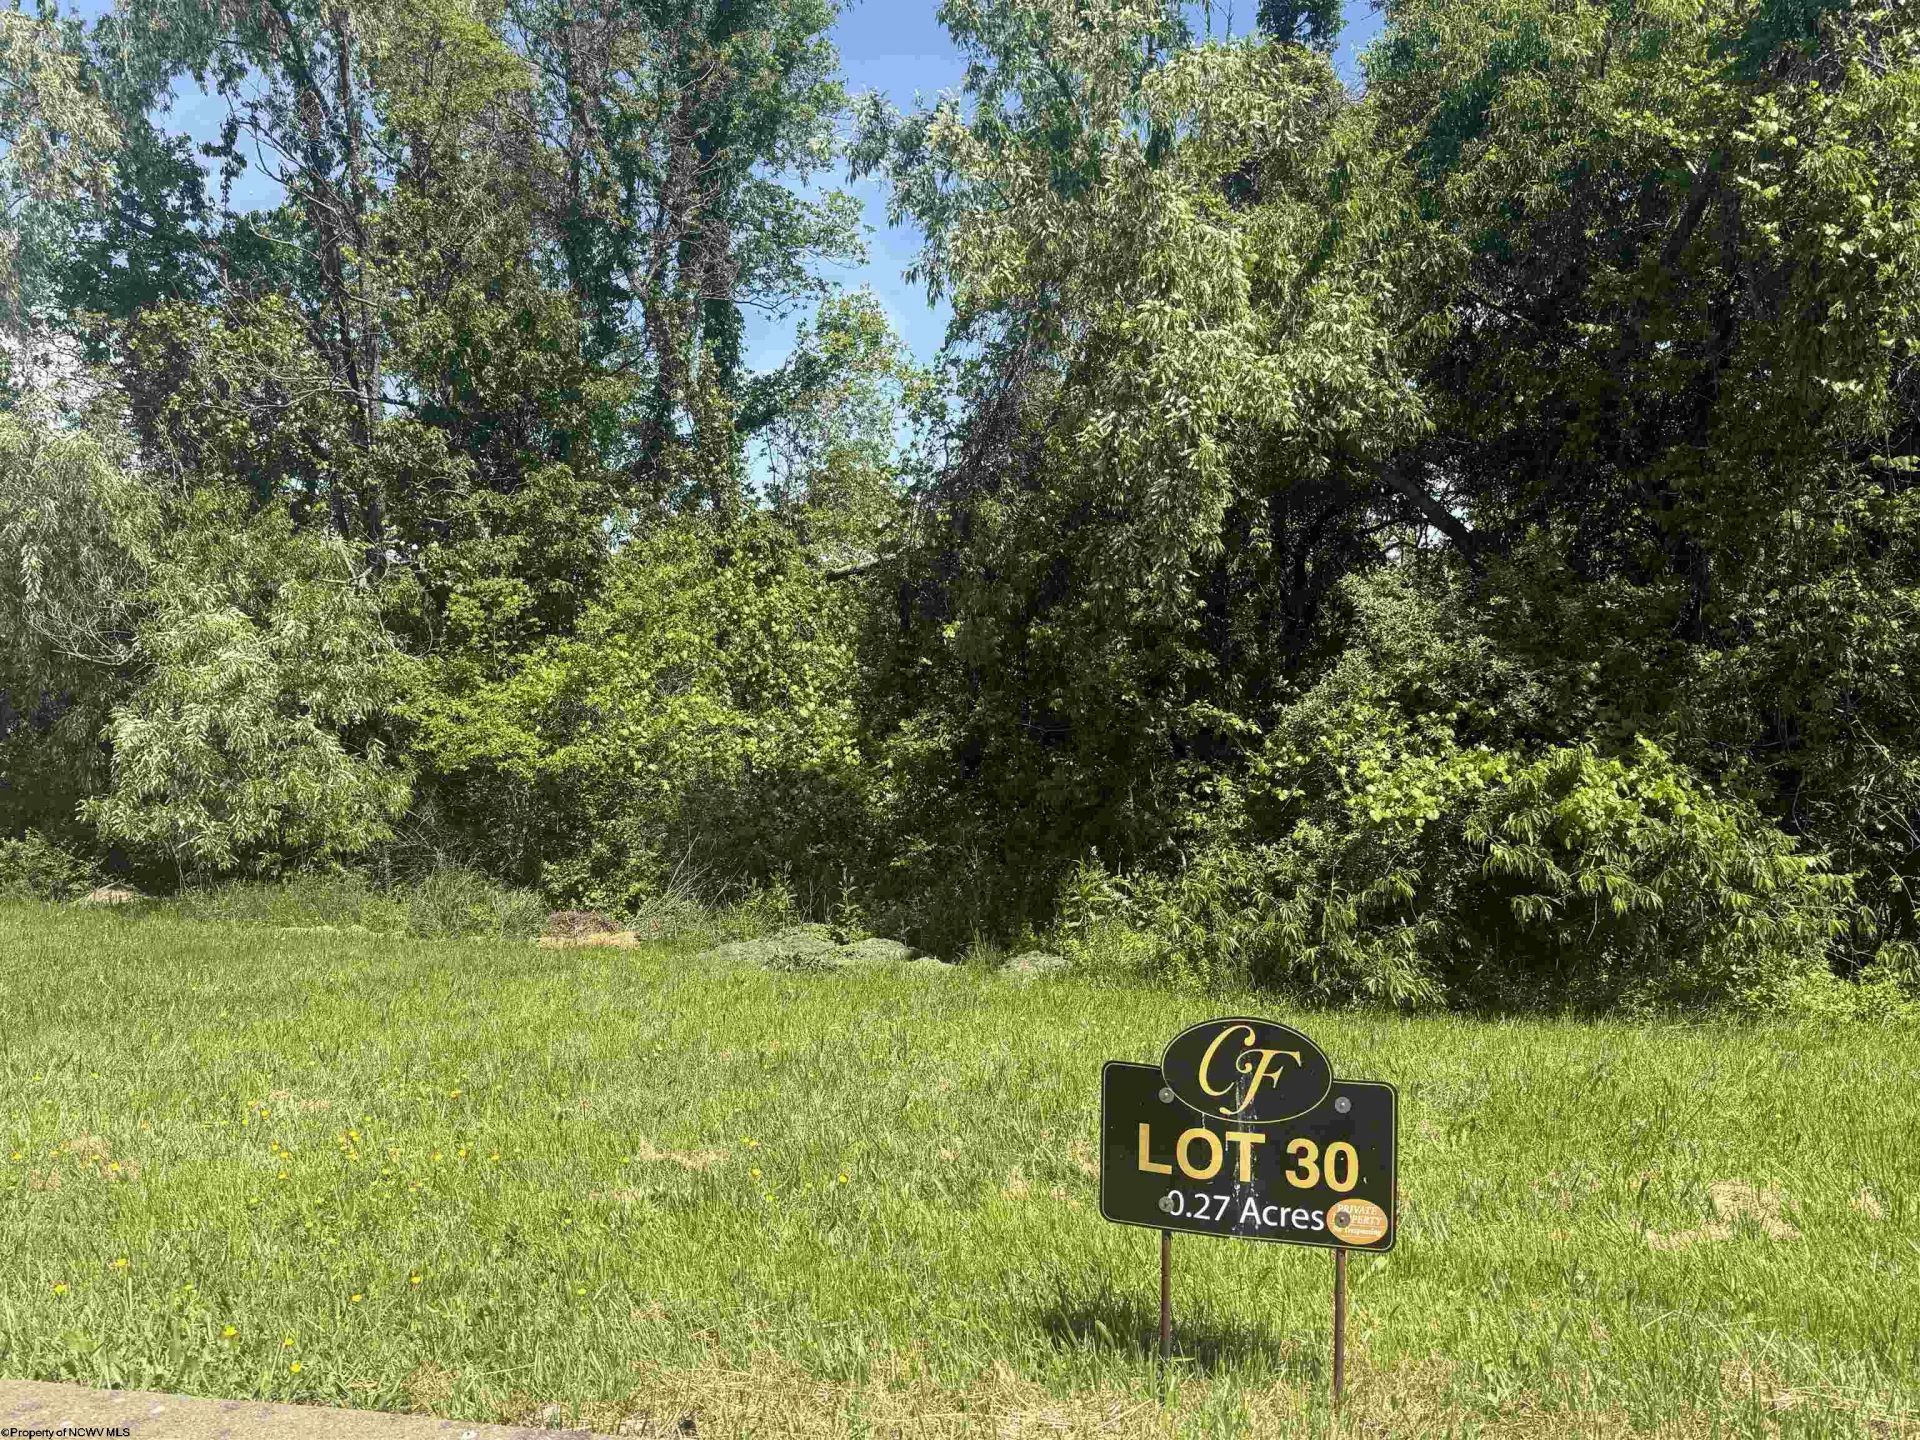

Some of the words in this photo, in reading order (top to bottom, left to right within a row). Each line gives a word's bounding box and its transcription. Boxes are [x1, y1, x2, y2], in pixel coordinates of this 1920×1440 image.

[1198, 1024, 1301, 1115] CF
[1138, 1123, 1265, 1182] LOT
[1286, 1138, 1359, 1192] 30
[1167, 1189, 1230, 1221] 0.27
[1239, 1196, 1325, 1231] Acres
